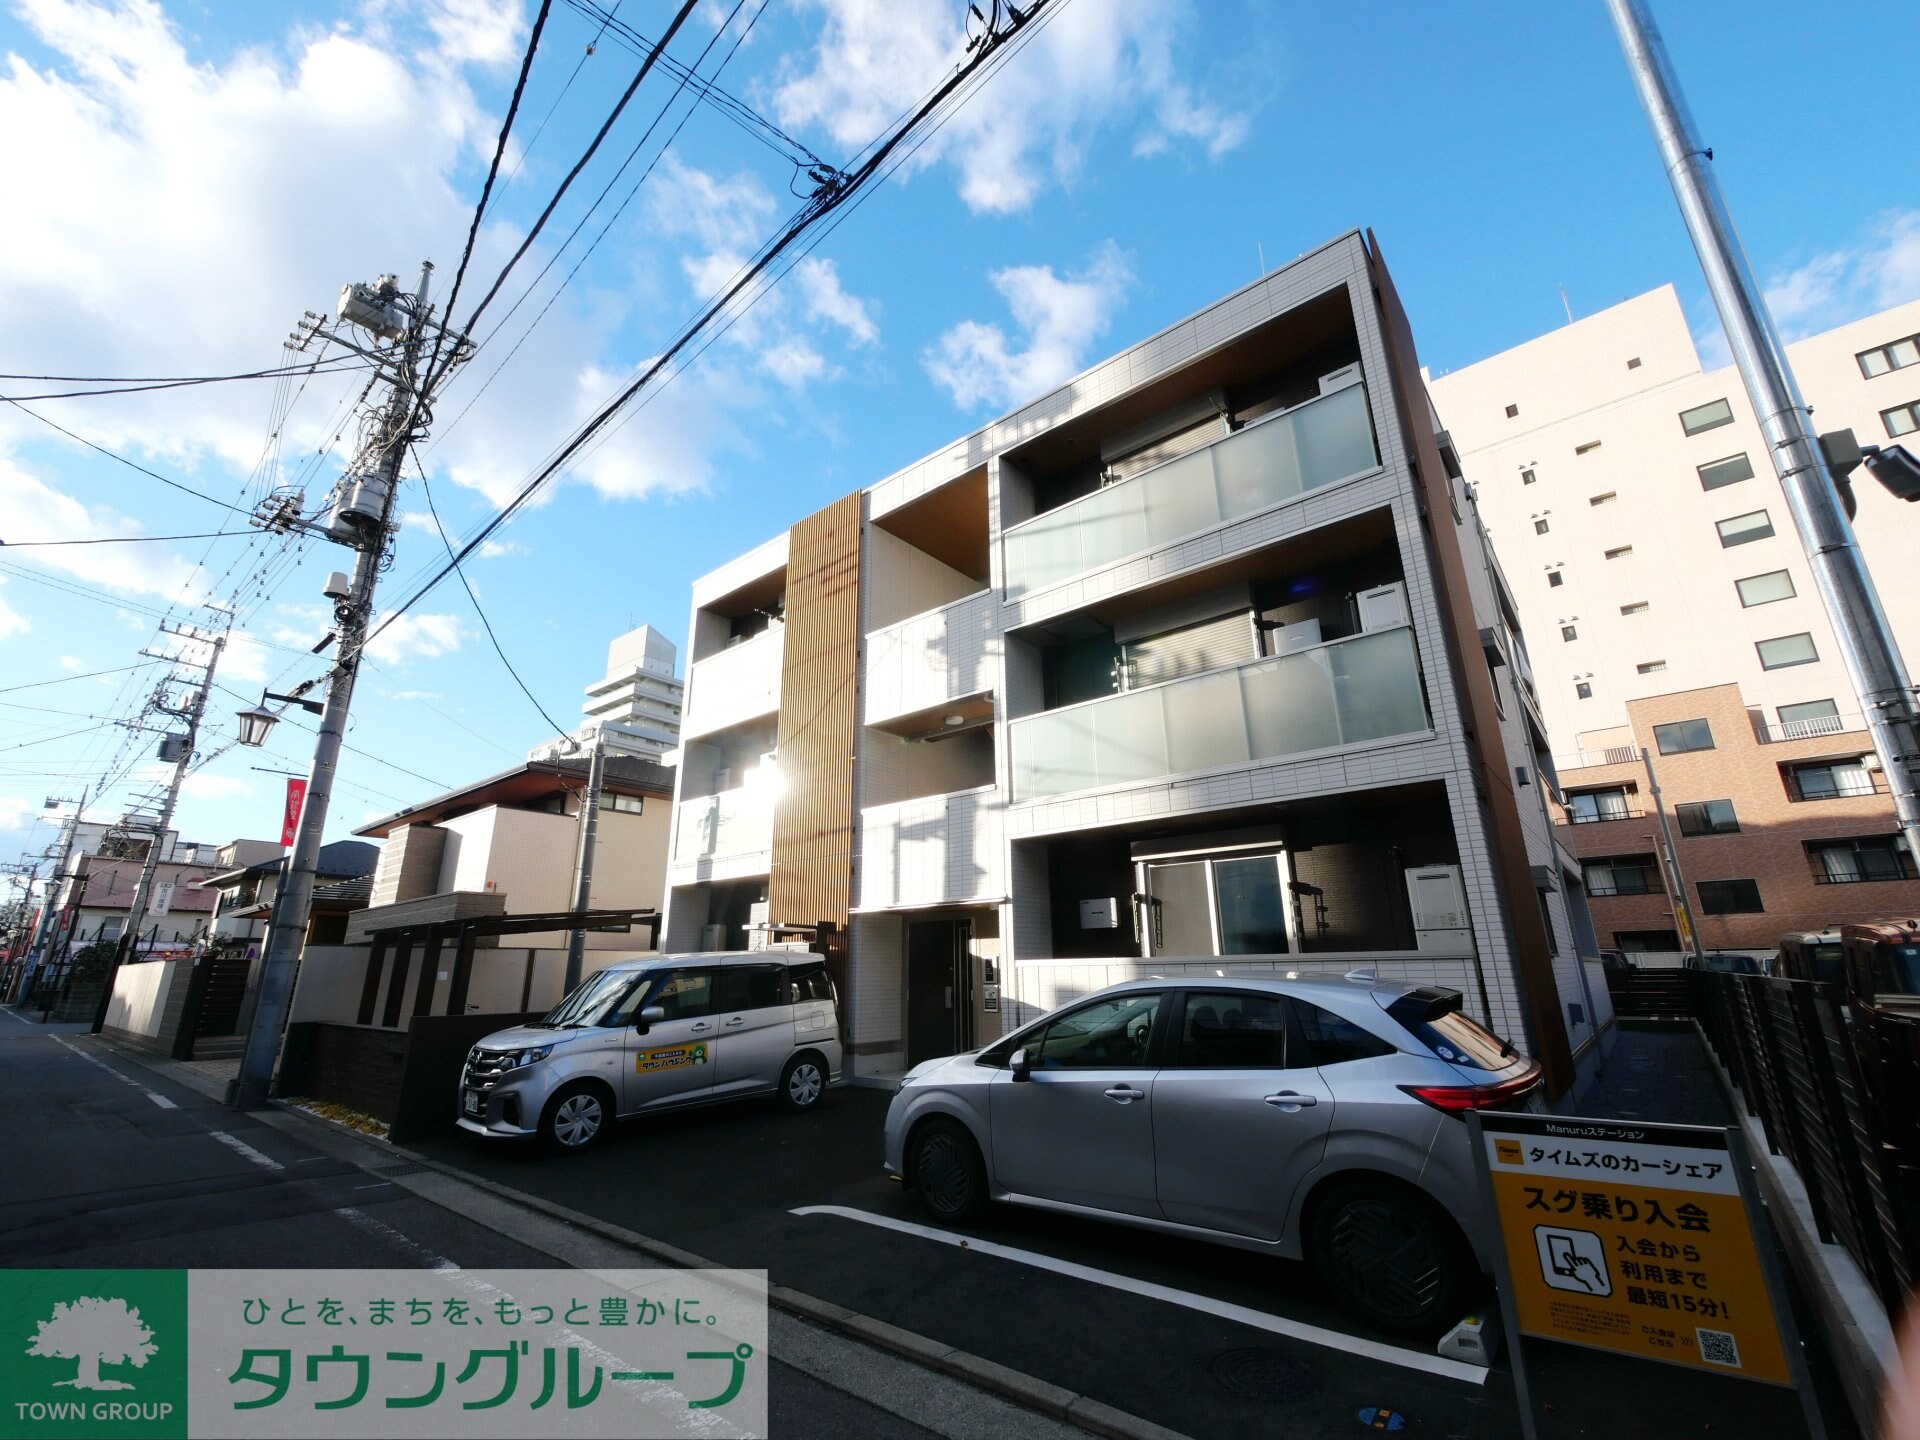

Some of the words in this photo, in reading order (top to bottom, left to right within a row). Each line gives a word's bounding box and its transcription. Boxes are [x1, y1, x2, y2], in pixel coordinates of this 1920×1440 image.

[1546, 1123, 1645, 1140] Manuruステーション
[1529, 1147, 1723, 1180] タイムズのカーシェア
[1523, 1186, 1712, 1232] スグ乗り入会
[1616, 1235, 1701, 1263] 入会から
[1620, 1260, 1709, 1290] 利用まで
[1626, 1285, 1731, 1320] 最短15分!
[1641, 1325, 1676, 1338] ご入会は
[1648, 1336, 1674, 1348] こちら
